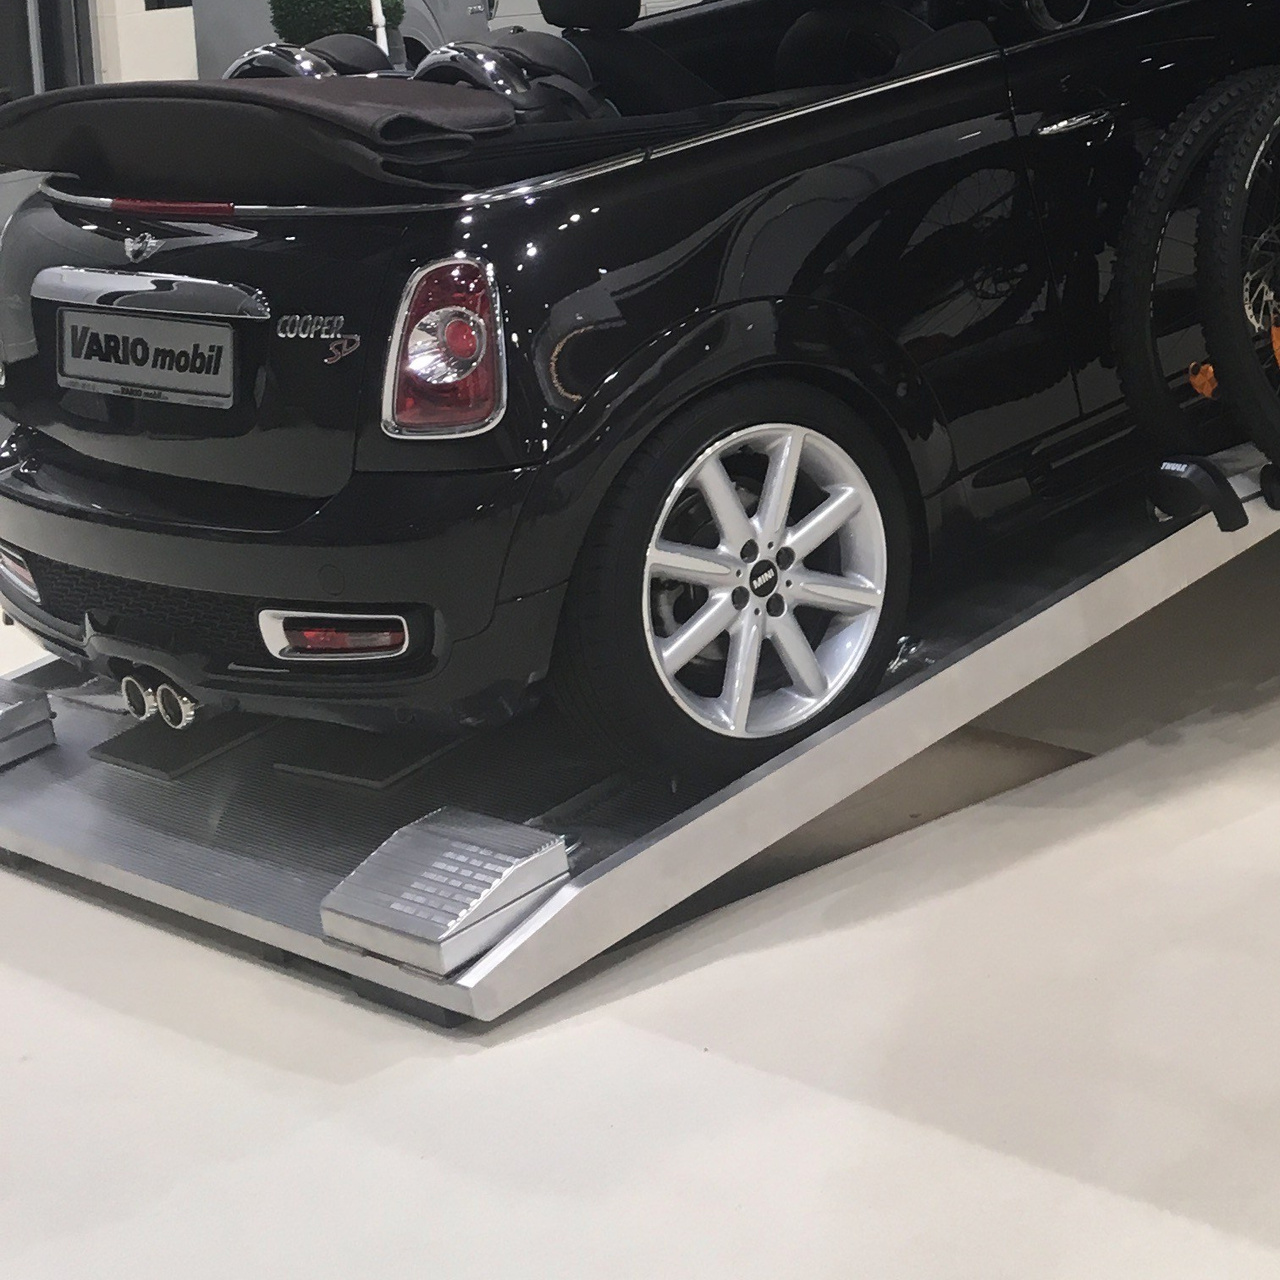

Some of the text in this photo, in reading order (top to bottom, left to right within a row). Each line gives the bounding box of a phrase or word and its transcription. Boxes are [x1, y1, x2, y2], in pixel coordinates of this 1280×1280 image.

[277, 314, 345, 339] COOPER
[70, 324, 224, 376] VARIO mobil
[323, 334, 361, 365] SD
[752, 568, 775, 589] MINI
